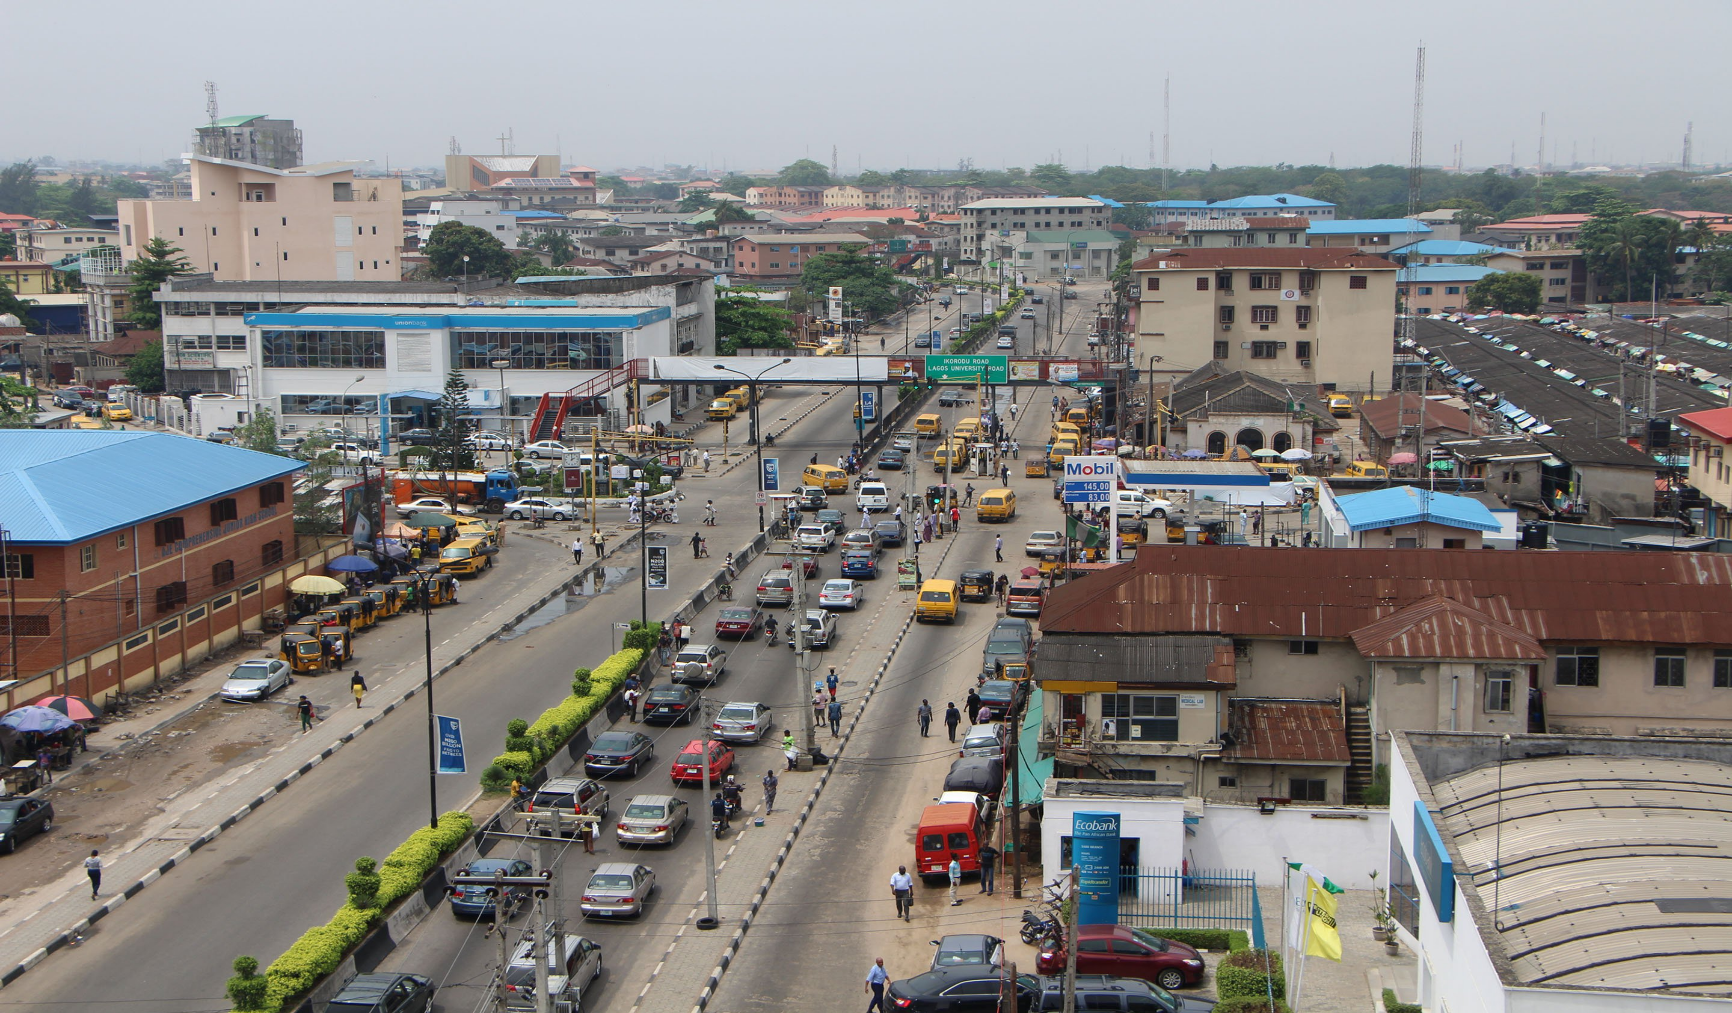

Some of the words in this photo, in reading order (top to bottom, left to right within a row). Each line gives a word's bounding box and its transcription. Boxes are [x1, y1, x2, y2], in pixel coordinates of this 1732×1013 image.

[1067, 463, 1114, 475] Mobil
[1084, 482, 1109, 491] 145.00
[174, 526, 221, 552] COMPREHENSIVE
[223, 519, 243, 534] JUNIOR
[244, 513, 257, 526] HIGH
[258, 506, 278, 521] SCHOOL
[1076, 818, 1118, 830] Ecobank
